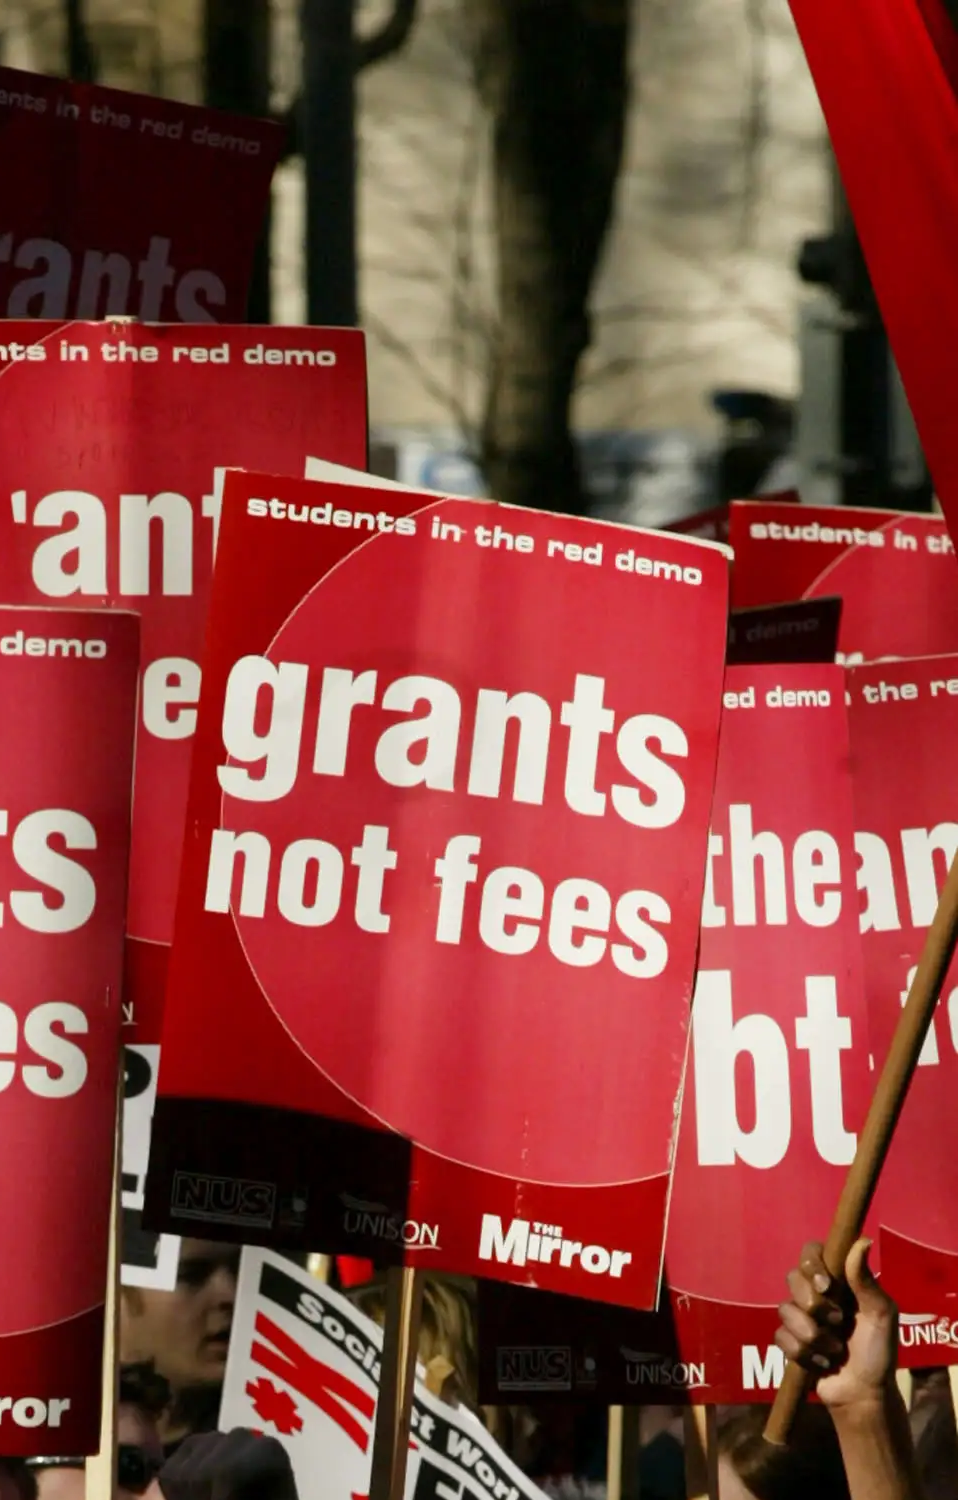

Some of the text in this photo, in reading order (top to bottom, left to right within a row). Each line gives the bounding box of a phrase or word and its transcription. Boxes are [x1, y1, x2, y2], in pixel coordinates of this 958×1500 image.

[56, 89, 79, 118] in
[90, 105, 132, 130] the
[140, 117, 182, 140] red
[191, 125, 261, 156] demo
[60, 340, 88, 362] in
[101, 341, 158, 363] the
[172, 342, 229, 364] red
[243, 345, 336, 366] demo
[247, 497, 703, 587] students in the red demo
[750, 521, 883, 548] students
[894, 530, 917, 552] in
[0, 631, 107, 658] demo
[766, 687, 832, 707] demo
[862, 680, 917, 704] the
[216, 654, 689, 830] grants
[204, 824, 672, 980] not fees
[175, 1176, 272, 1216] NUS
[343, 1211, 440, 1246] UNISON
[533, 1222, 563, 1237] THE
[478, 1213, 632, 1278] Mirror
[501, 1350, 569, 1381] NUS
[625, 1362, 706, 1385] UNISON
